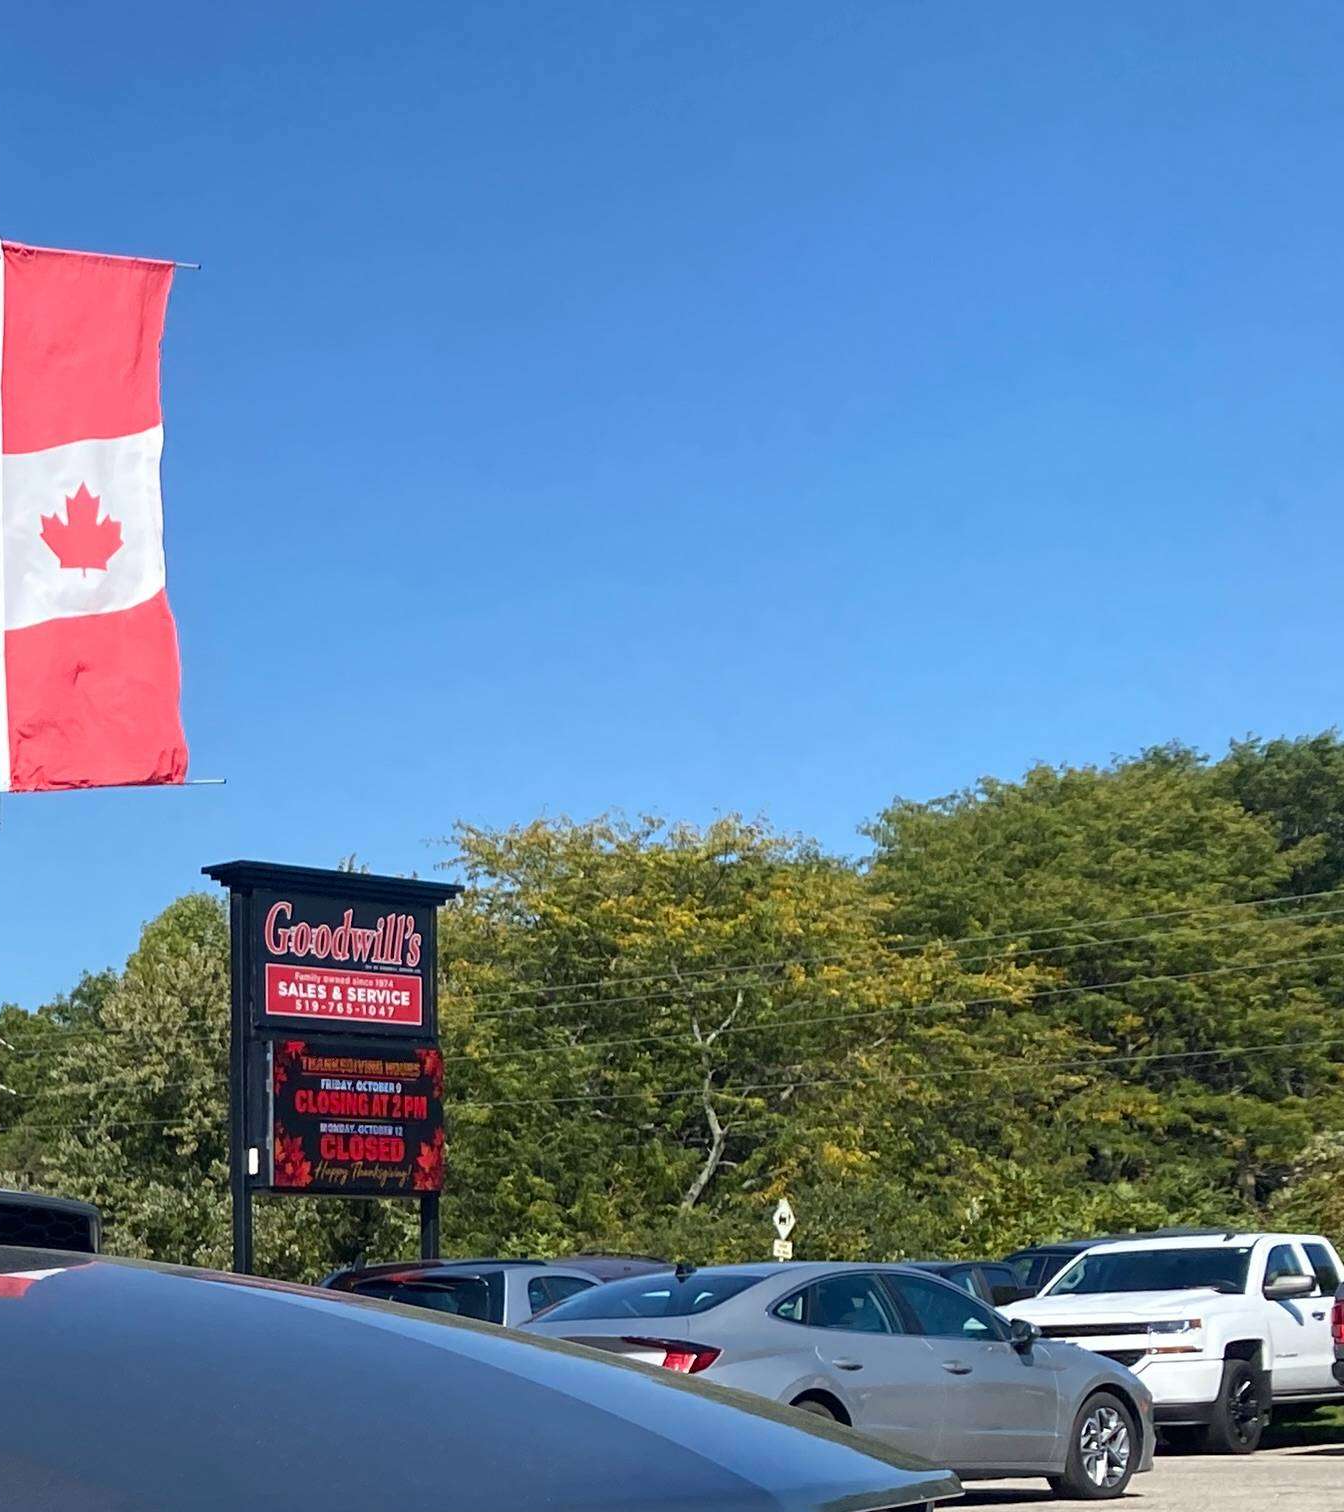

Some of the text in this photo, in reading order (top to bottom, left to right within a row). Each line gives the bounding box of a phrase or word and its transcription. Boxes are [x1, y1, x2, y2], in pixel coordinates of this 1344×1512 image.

[265, 901, 421, 967] Goodwill's
[294, 972, 321, 984] Family
[323, 974, 350, 985] owned
[352, 976, 374, 987] since
[278, 981, 410, 1006] SALES & SERVICE
[295, 999, 395, 1018] 519-765-1047
[321, 1078, 354, 1092] FRIDAY,
[356, 1081, 395, 1094] OCTOBER
[294, 1089, 427, 1120] CLOSING AT 2 PM
[358, 1124, 394, 1136] OCTOBER
[395, 1126, 403, 1137] 12
[320, 1135, 405, 1162] CLOSED
[314, 1160, 412, 1188] Happy Thanksgiving!
